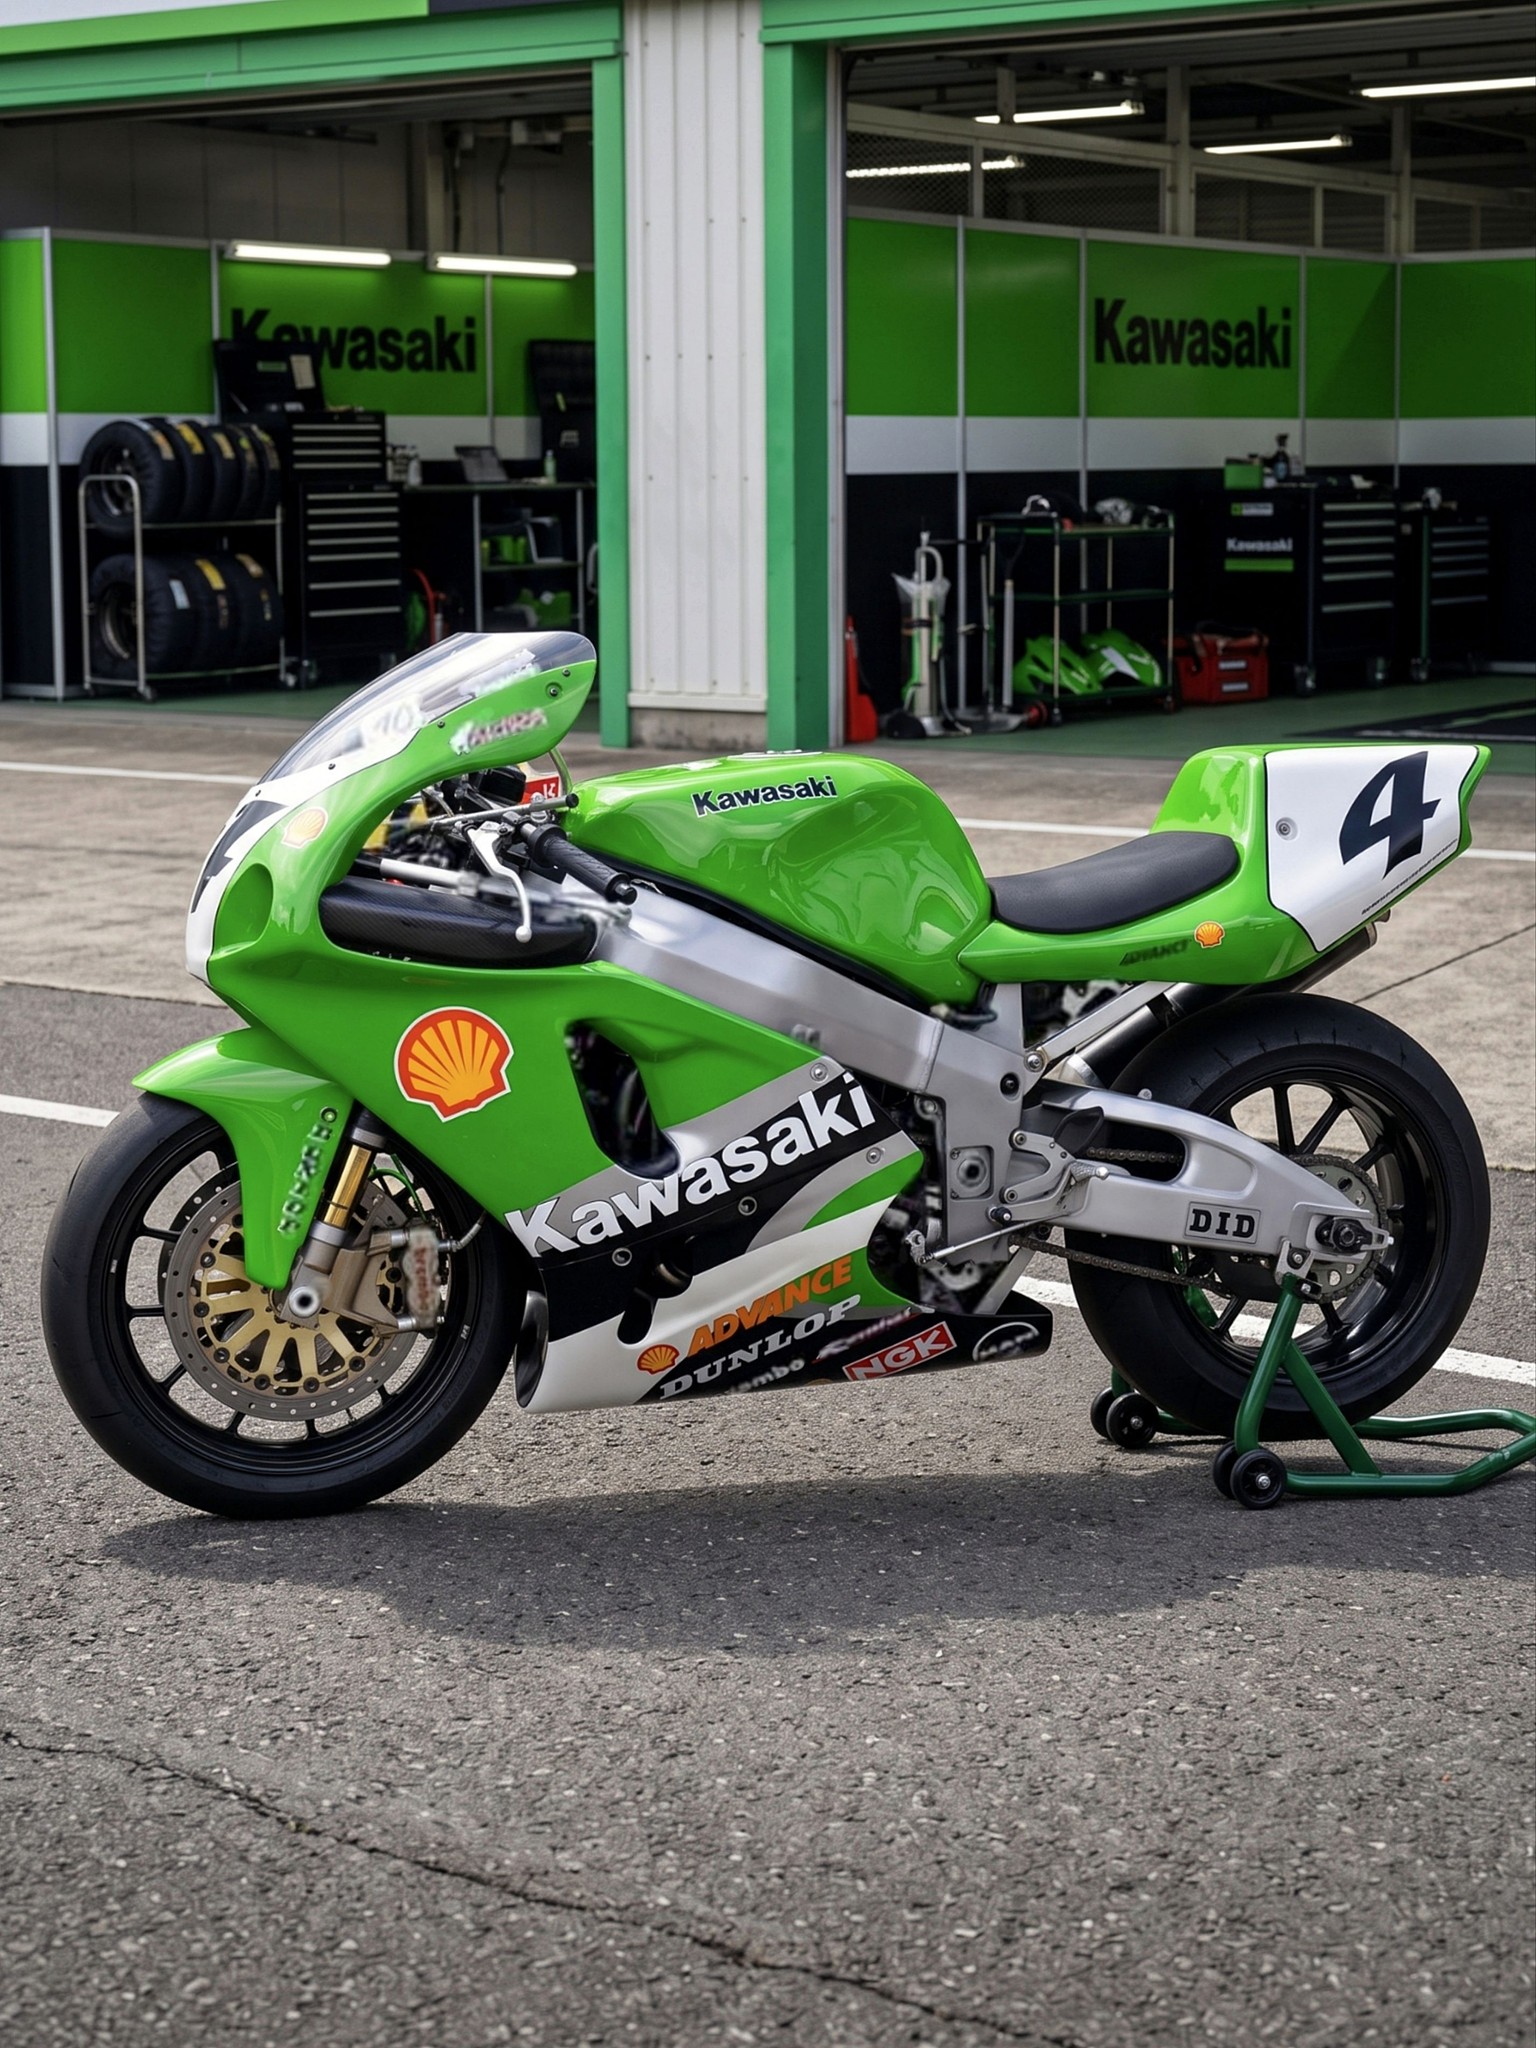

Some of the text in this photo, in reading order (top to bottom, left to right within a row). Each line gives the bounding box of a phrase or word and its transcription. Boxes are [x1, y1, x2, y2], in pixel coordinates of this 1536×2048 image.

[1094, 298, 1292, 369] Kawasaki
[691, 775, 838, 817] Kawasaki
[1339, 751, 1442, 880] 4
[504, 1072, 876, 1258] Kawasaki
[1189, 1208, 1256, 1239] DID
[659, 1294, 861, 1400] DUNLOP
[686, 1256, 852, 1359] ADVANCE
[851, 1329, 948, 1380] NGK
